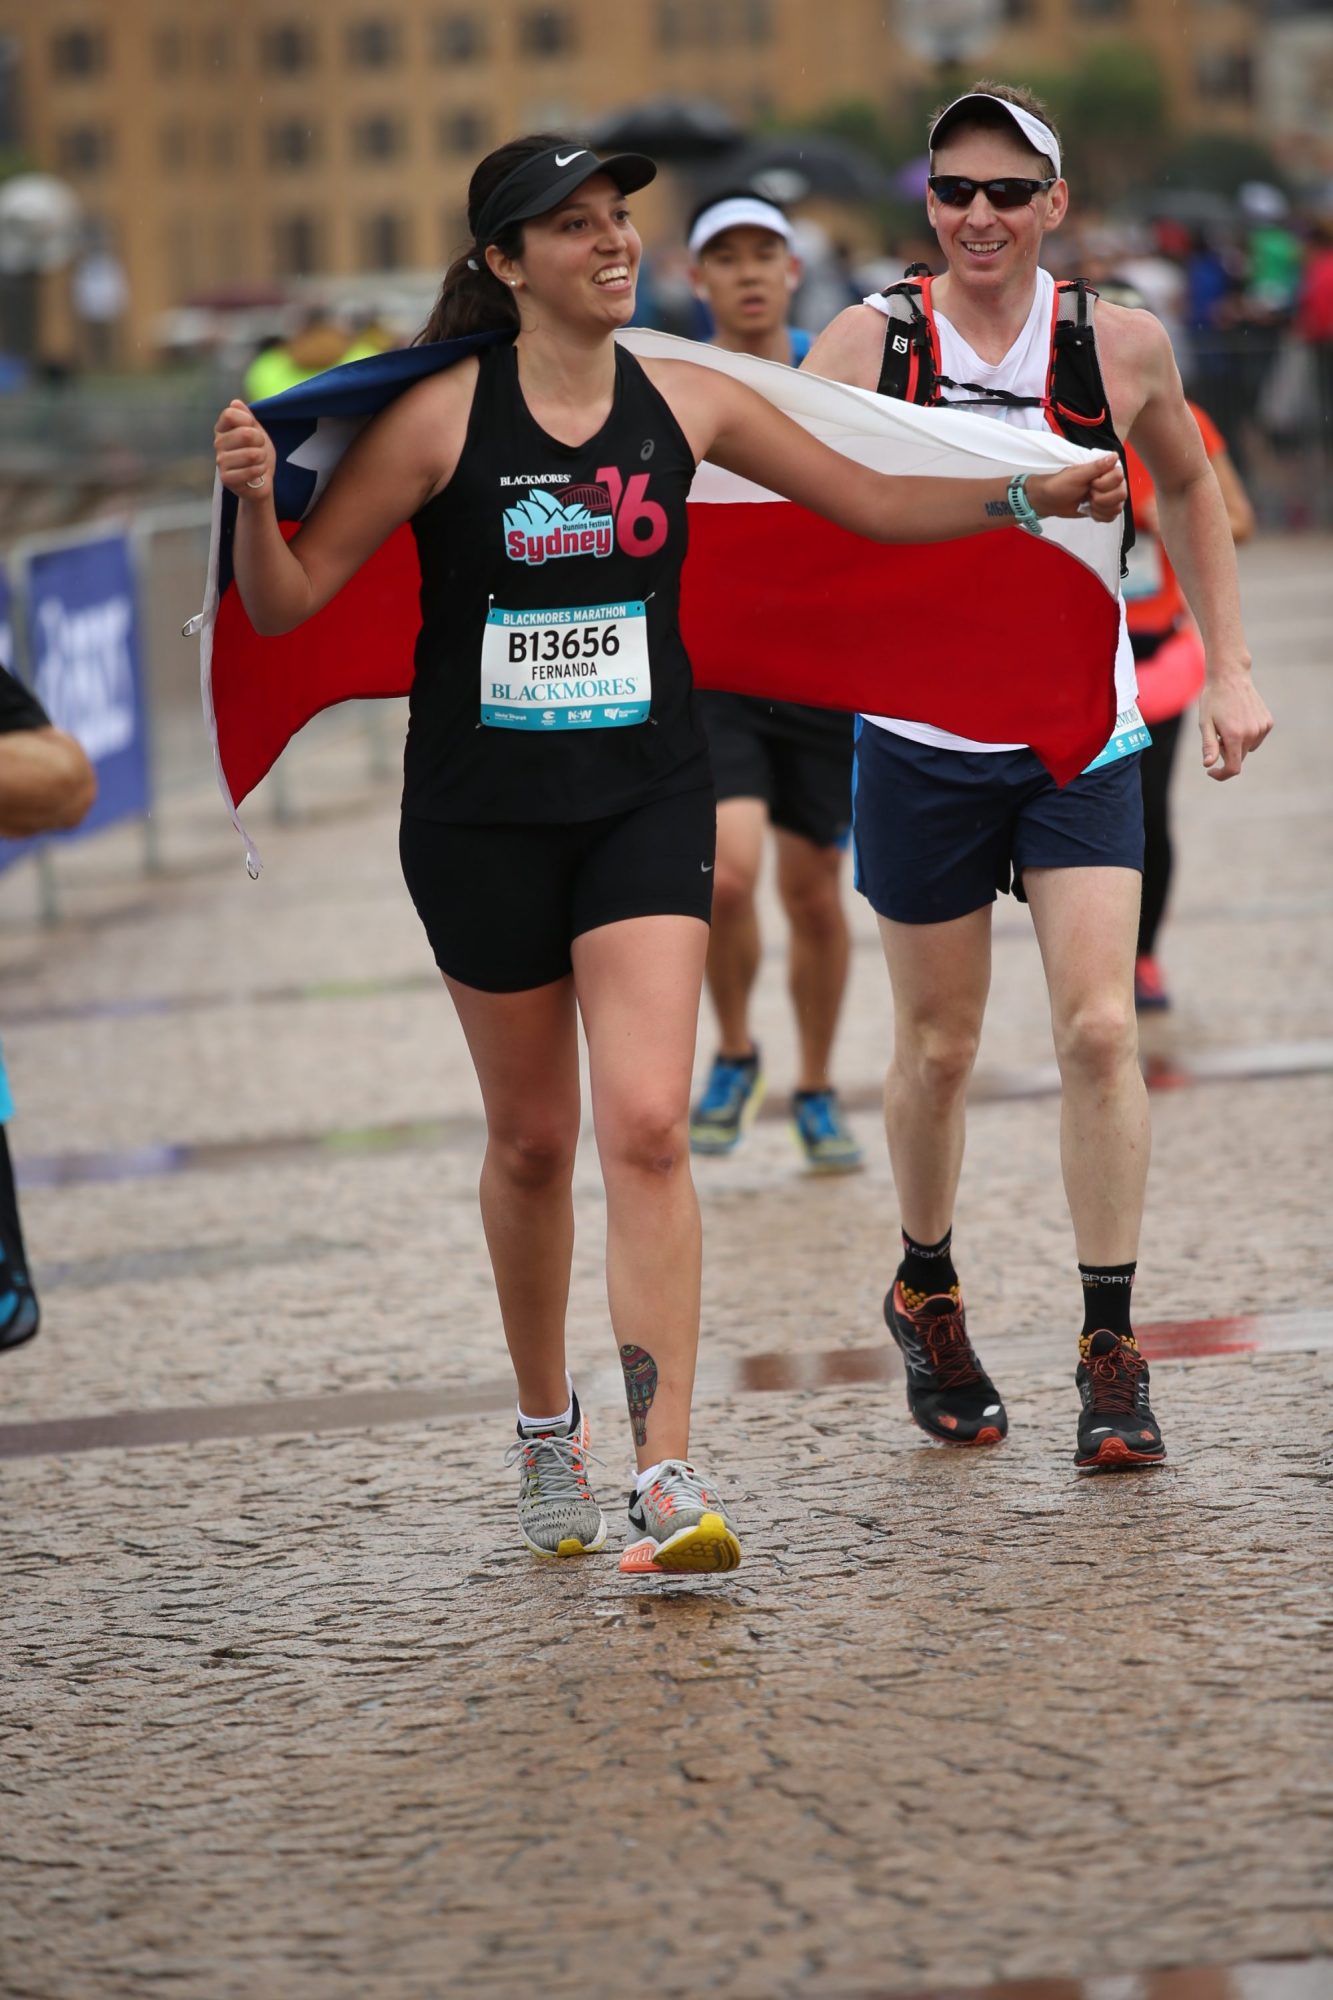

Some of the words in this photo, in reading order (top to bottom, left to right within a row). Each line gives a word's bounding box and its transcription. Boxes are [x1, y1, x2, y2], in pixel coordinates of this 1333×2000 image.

[500, 474, 570, 487] BLACKMORES
[595, 466, 668, 558] 16
[562, 522, 588, 532] Running
[589, 518, 610, 528] Festival
[507, 527, 612, 564] Sydney
[503, 611, 571, 625] BLACKMORES
[573, 606, 626, 621] MARATHON
[508, 624, 620, 663] B13656
[532, 662, 597, 680] FERNANDA
[491, 677, 636, 701] BLACKMORES
[1080, 1273, 1130, 1285] SPORT
